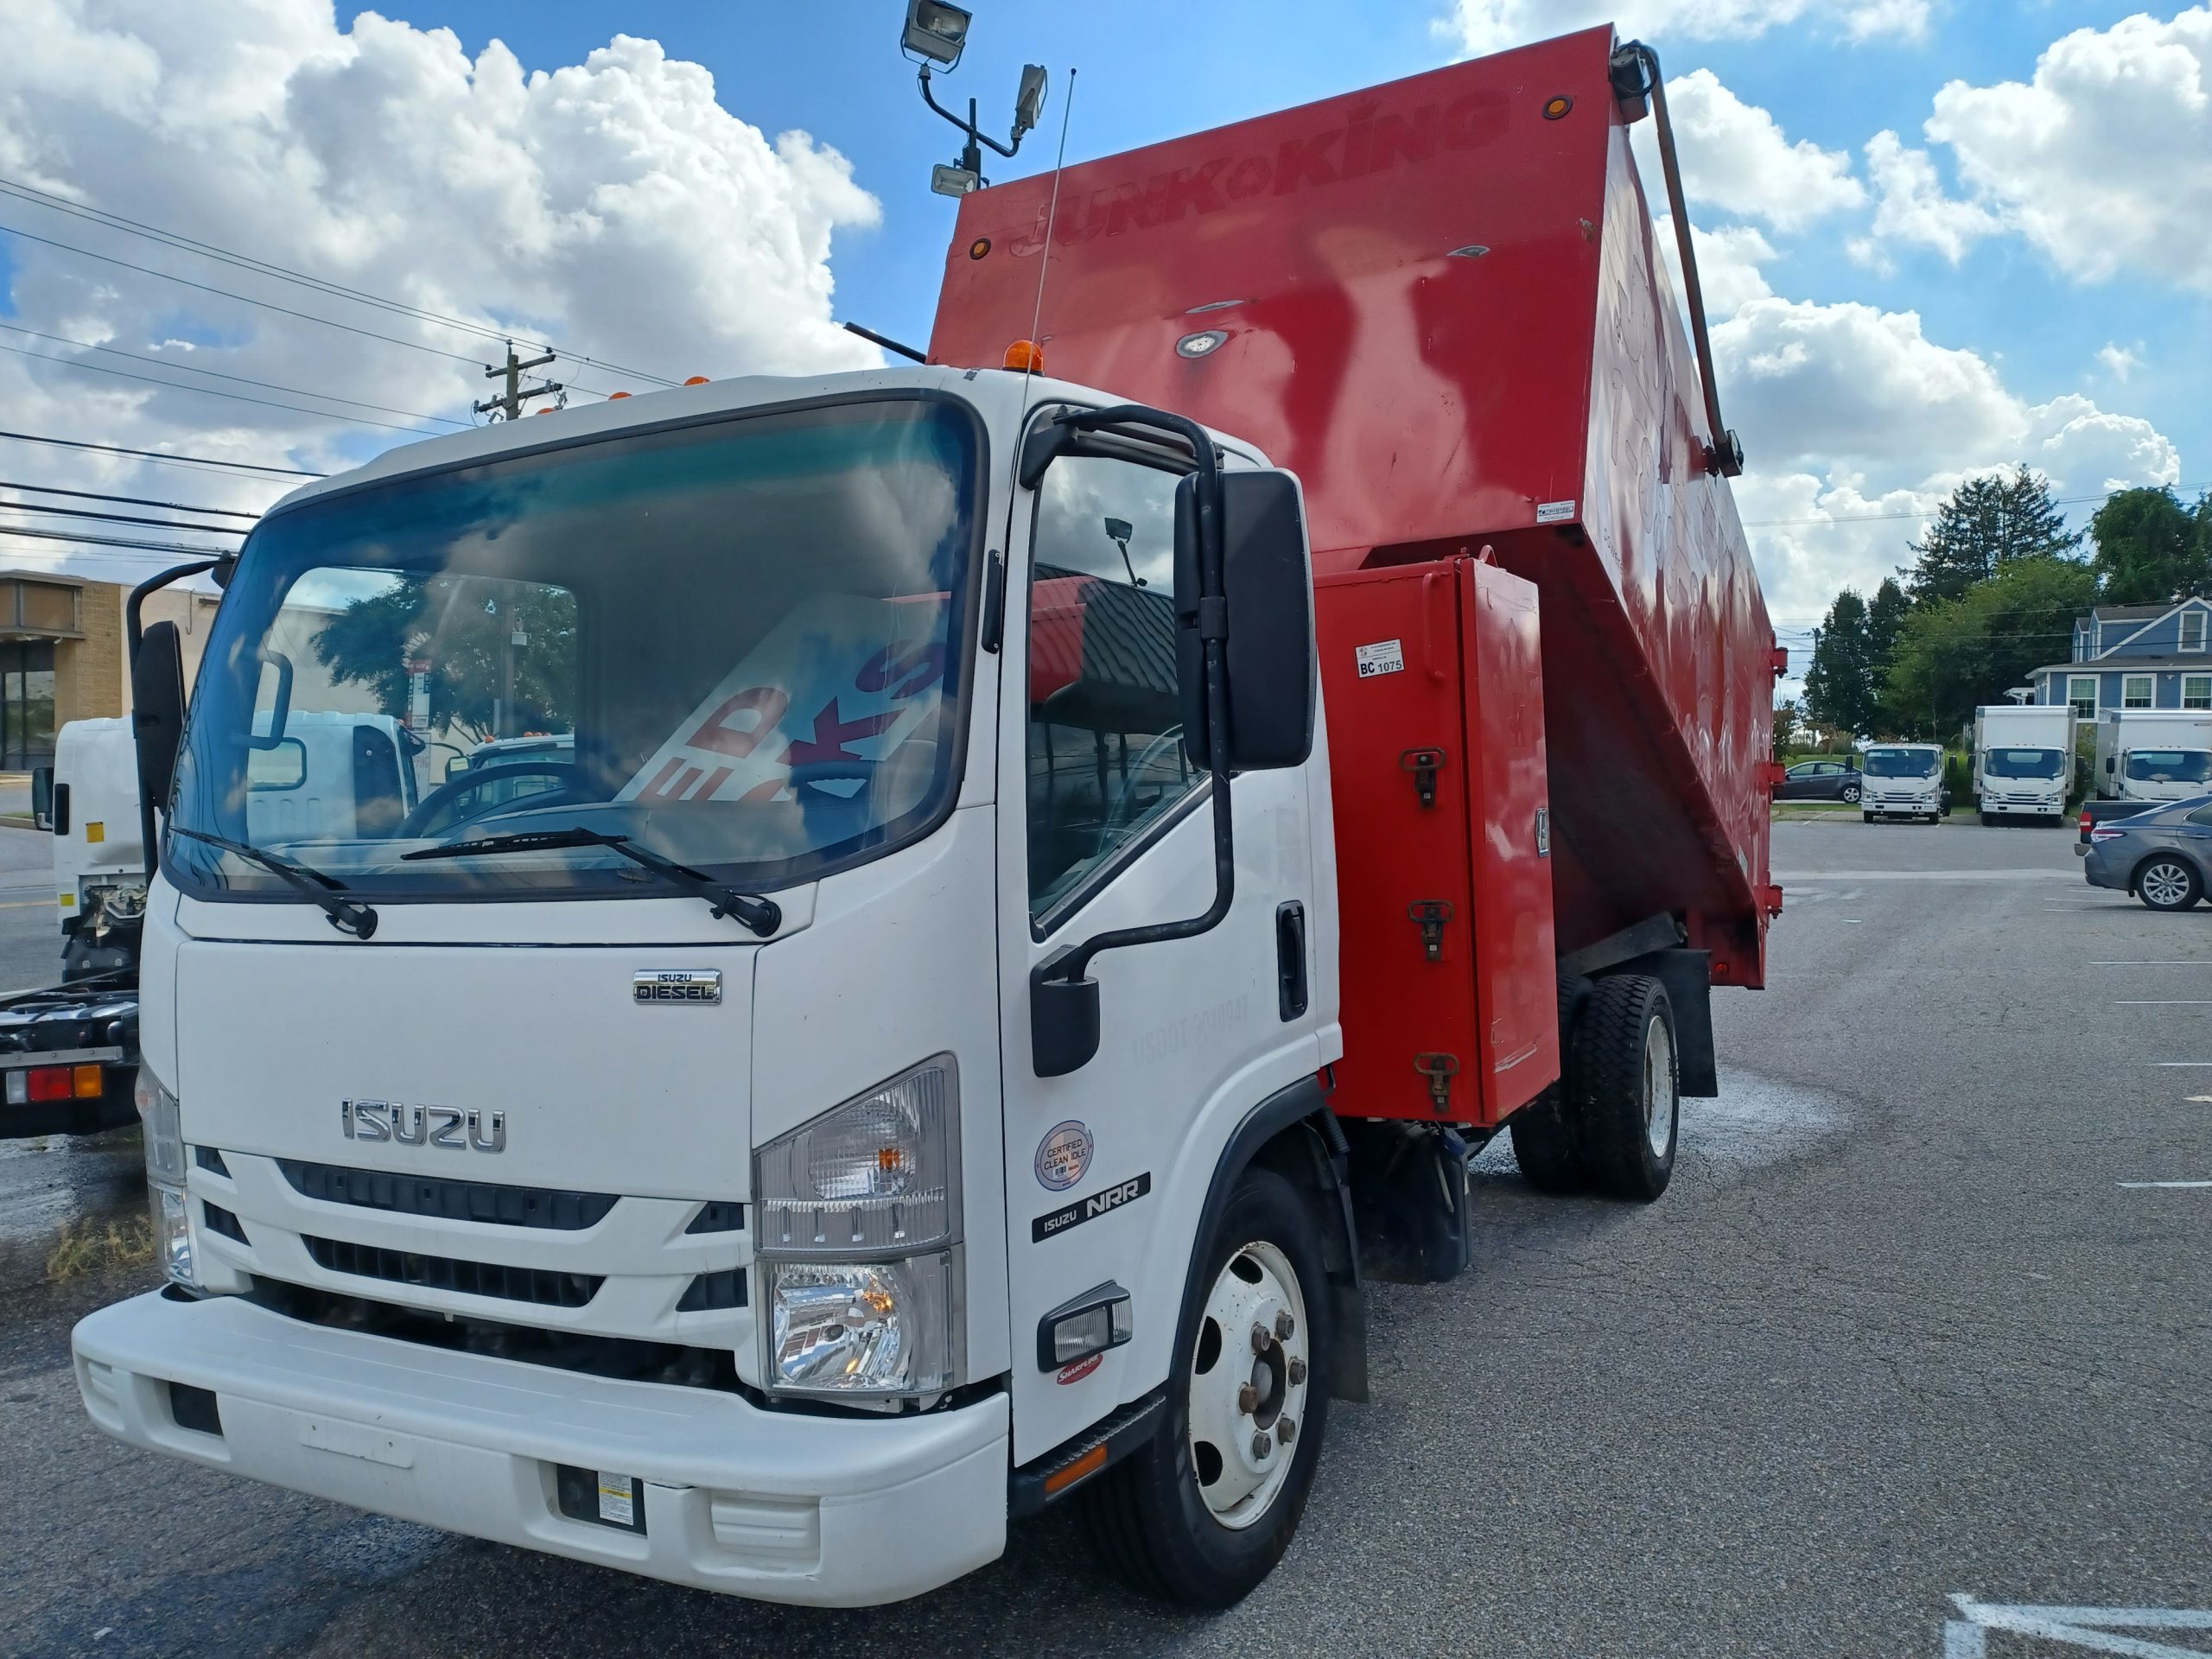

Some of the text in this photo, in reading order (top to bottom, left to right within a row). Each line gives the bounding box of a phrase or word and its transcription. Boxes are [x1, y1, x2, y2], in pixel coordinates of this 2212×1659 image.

[1274, 89, 1510, 196] KING
[1360, 660, 1402, 675] BC 1075
[658, 974, 692, 982] ISUZU
[636, 985, 714, 1000] DIESEL
[341, 1097, 506, 1154] ISUZU
[1044, 1147, 1086, 1170] CLEAN IDLE
[1046, 1139, 1083, 1158] CERTIFIED
[1044, 1179, 1139, 1232] ISUZU NRR
